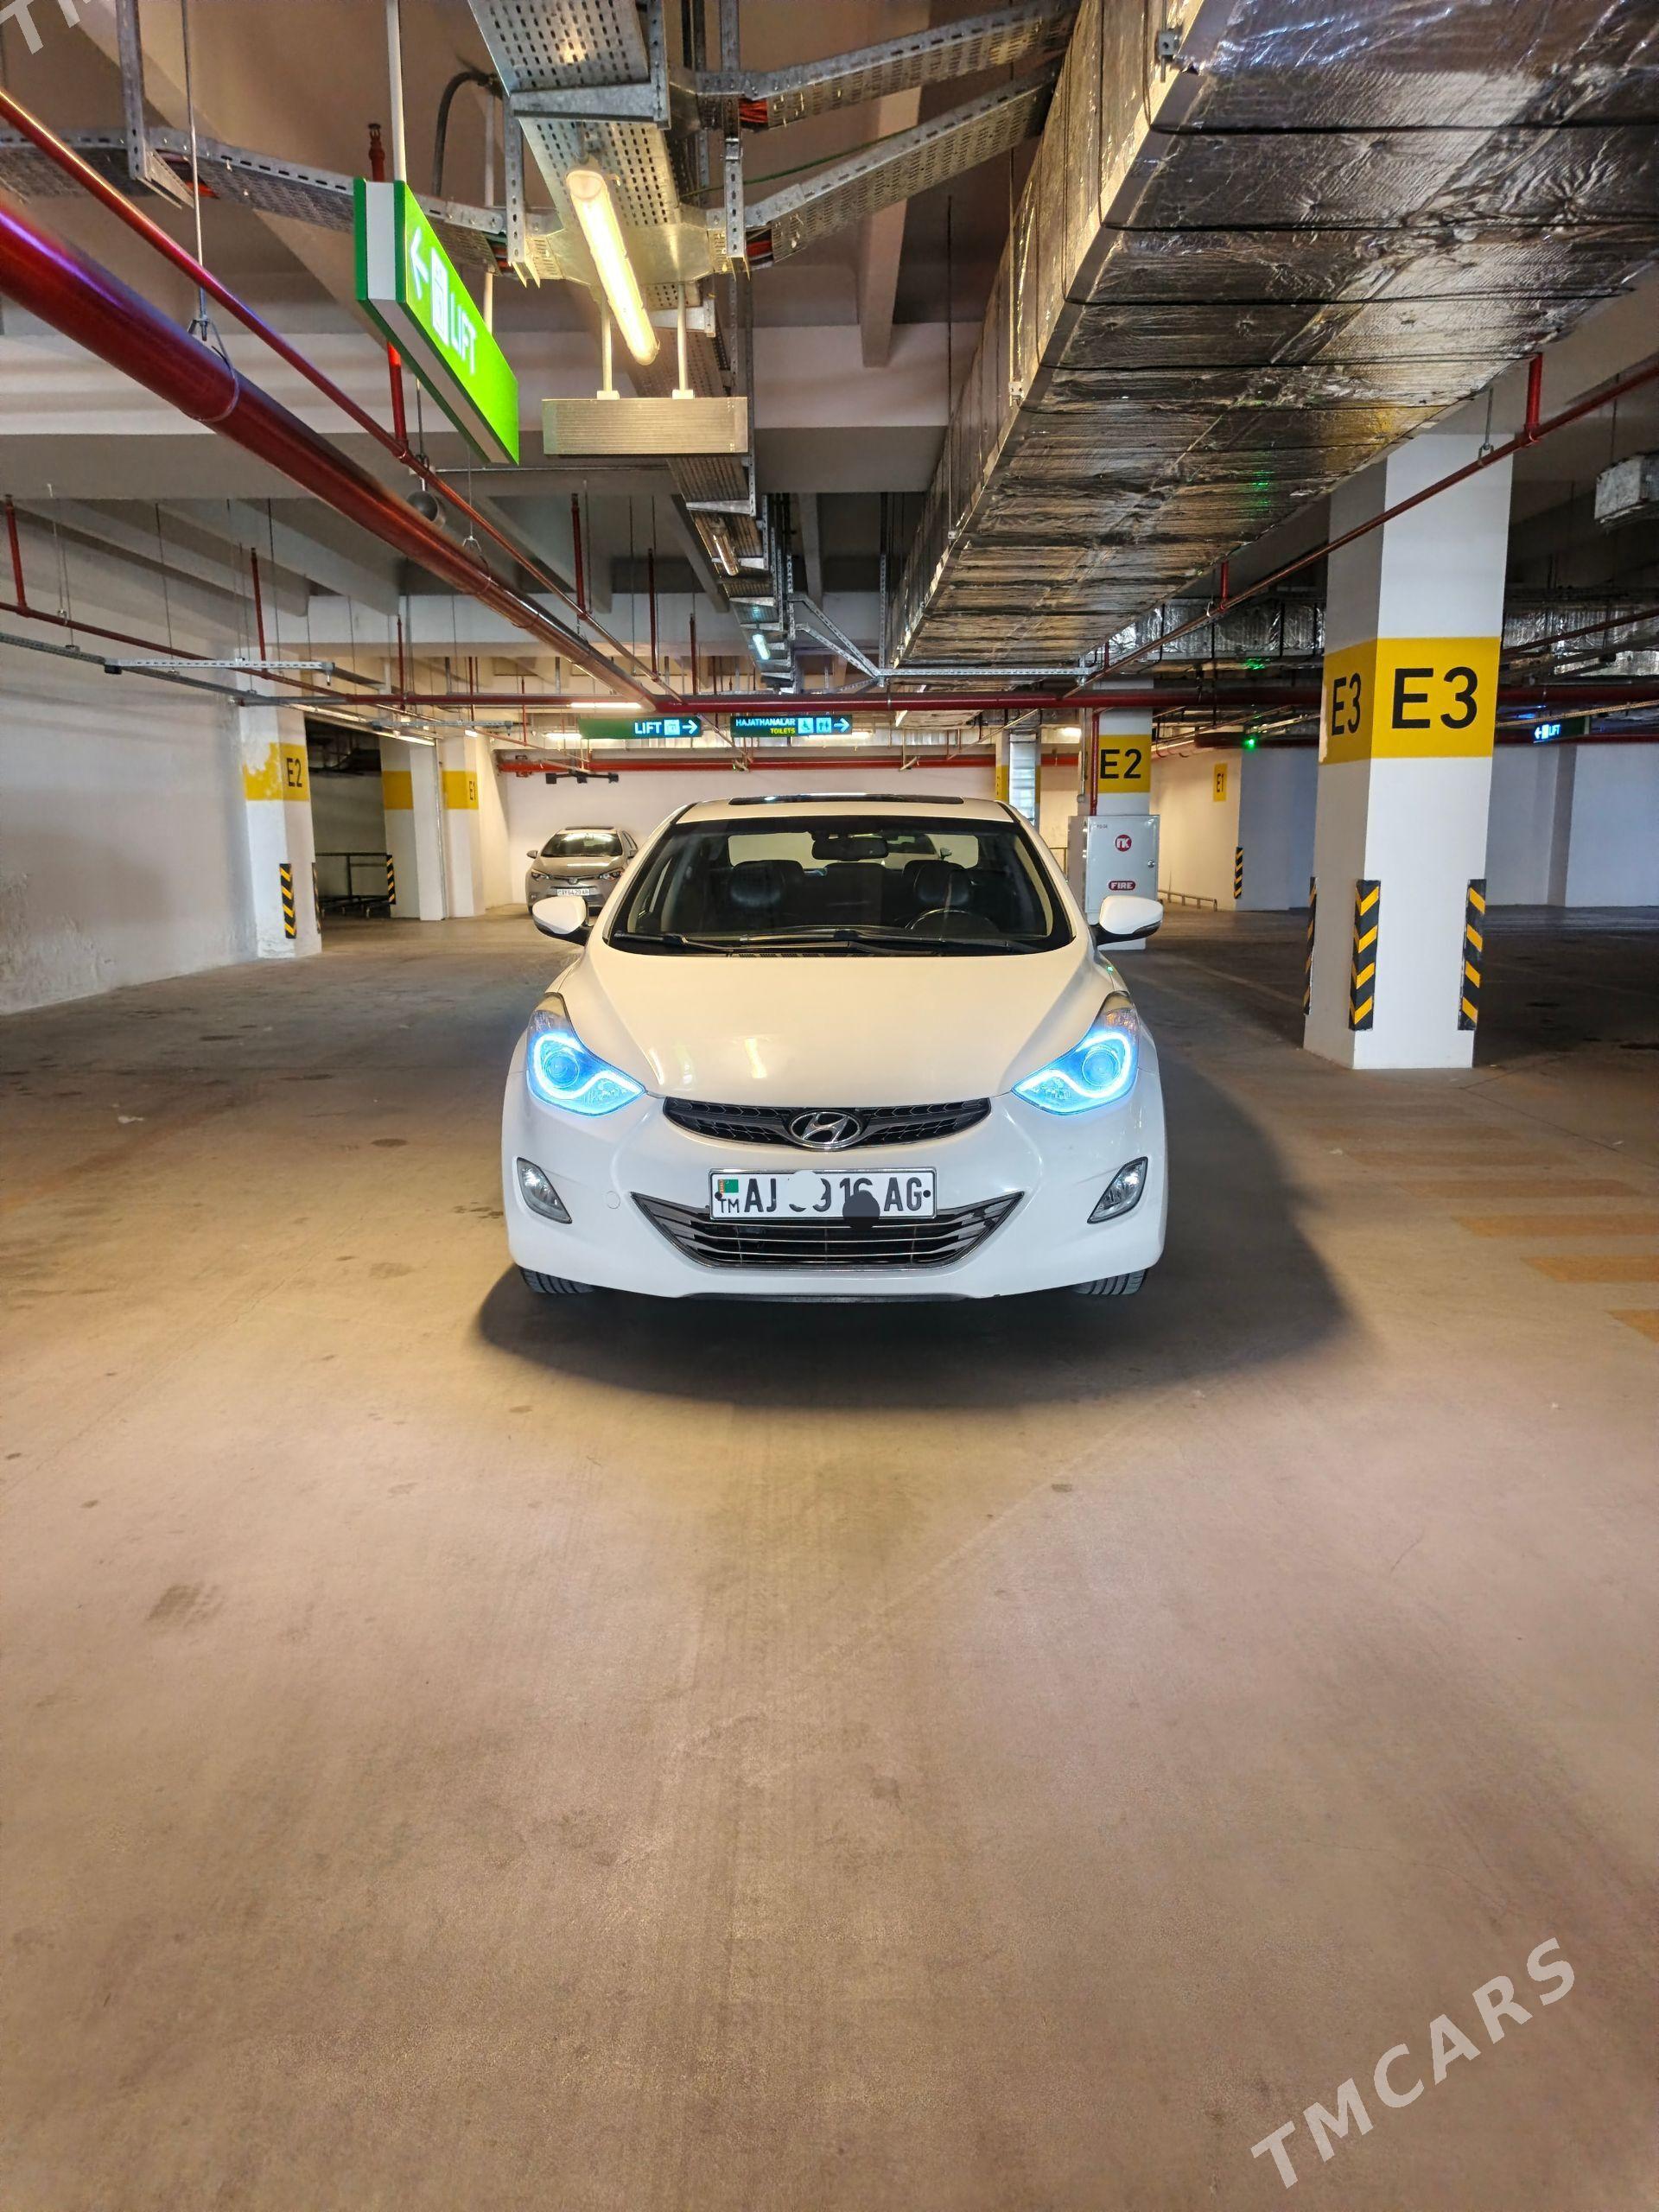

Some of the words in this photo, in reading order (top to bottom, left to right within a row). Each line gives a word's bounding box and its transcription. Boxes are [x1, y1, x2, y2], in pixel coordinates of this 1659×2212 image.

[449, 291, 478, 377] LIFT
[1332, 672, 1362, 735] E3
[1392, 666, 1478, 729] E3
[634, 722, 662, 734] LIFT
[735, 718, 796, 727] HAJATHANALAR
[1548, 724, 1560, 736] LIFT
[286, 758, 302, 787] E2
[1100, 748, 1141, 779] E2
[720, 1198, 740, 1213] TM
[744, 1178, 777, 1213] AJ
[883, 1177, 923, 1211] AG
